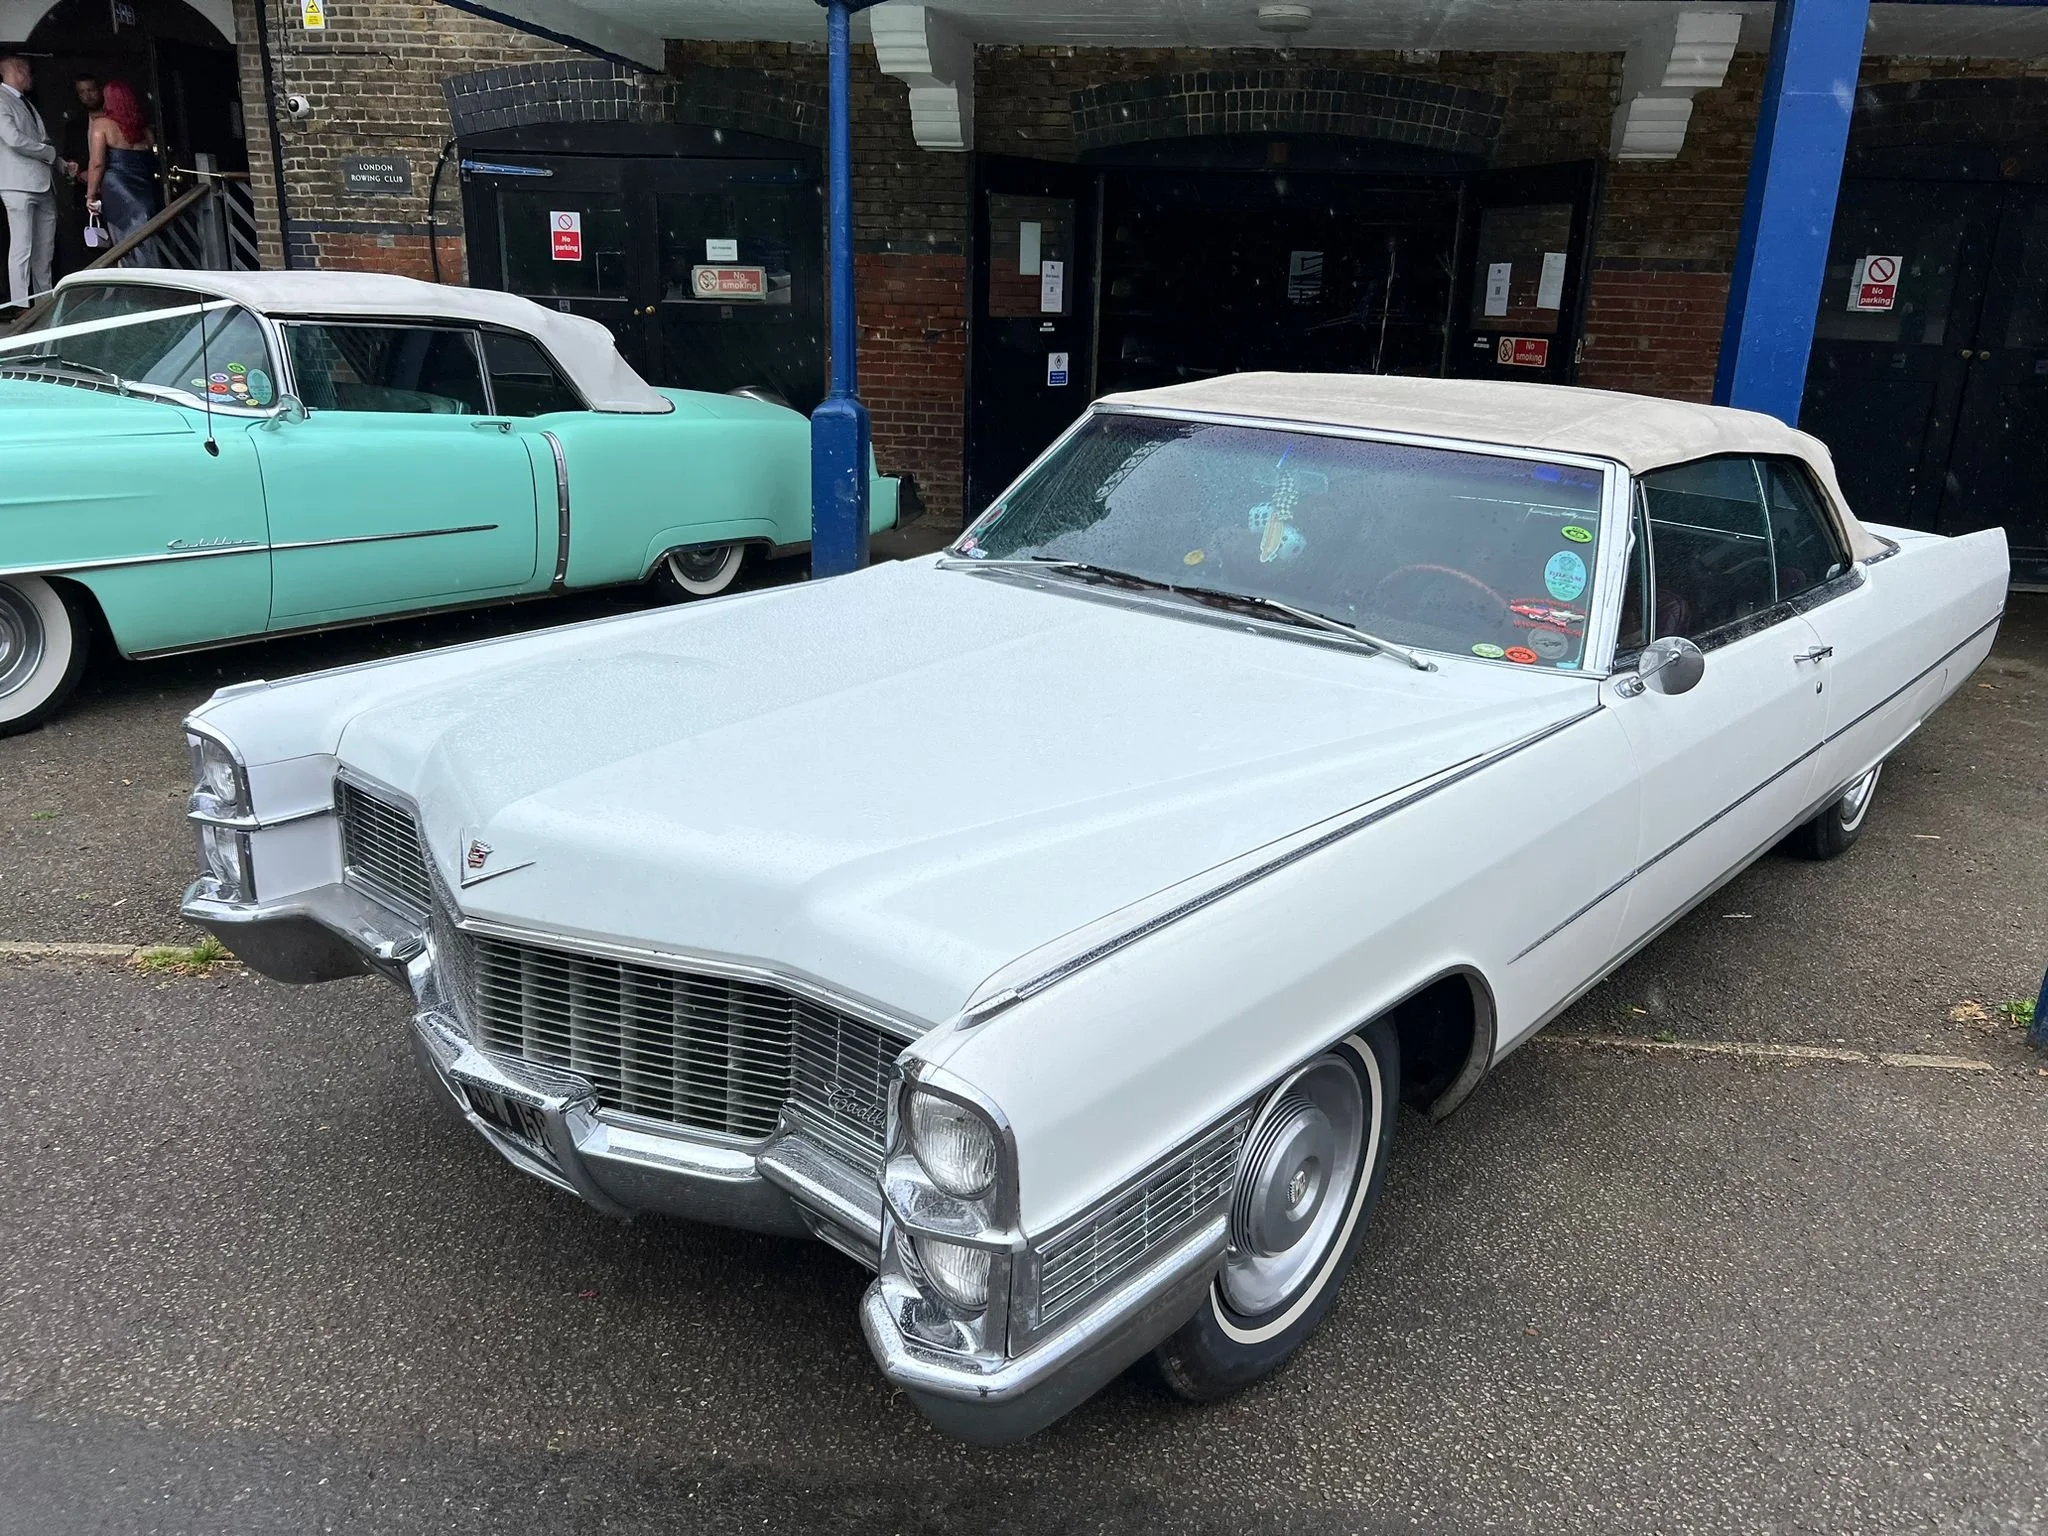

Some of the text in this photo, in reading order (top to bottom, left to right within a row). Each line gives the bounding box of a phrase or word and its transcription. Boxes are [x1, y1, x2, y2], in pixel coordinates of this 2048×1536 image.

[359, 163, 393, 172] LONDON
[351, 174, 404, 183] ROWING CLUB
[561, 235, 571, 243] No
[555, 244, 579, 253] parking
[733, 271, 746, 280] No
[722, 280, 758, 291] smoking
[1871, 287, 1884, 295] No
[1860, 297, 1891, 306] parking
[1525, 341, 1536, 350] No
[1515, 352, 1543, 365] smoking
